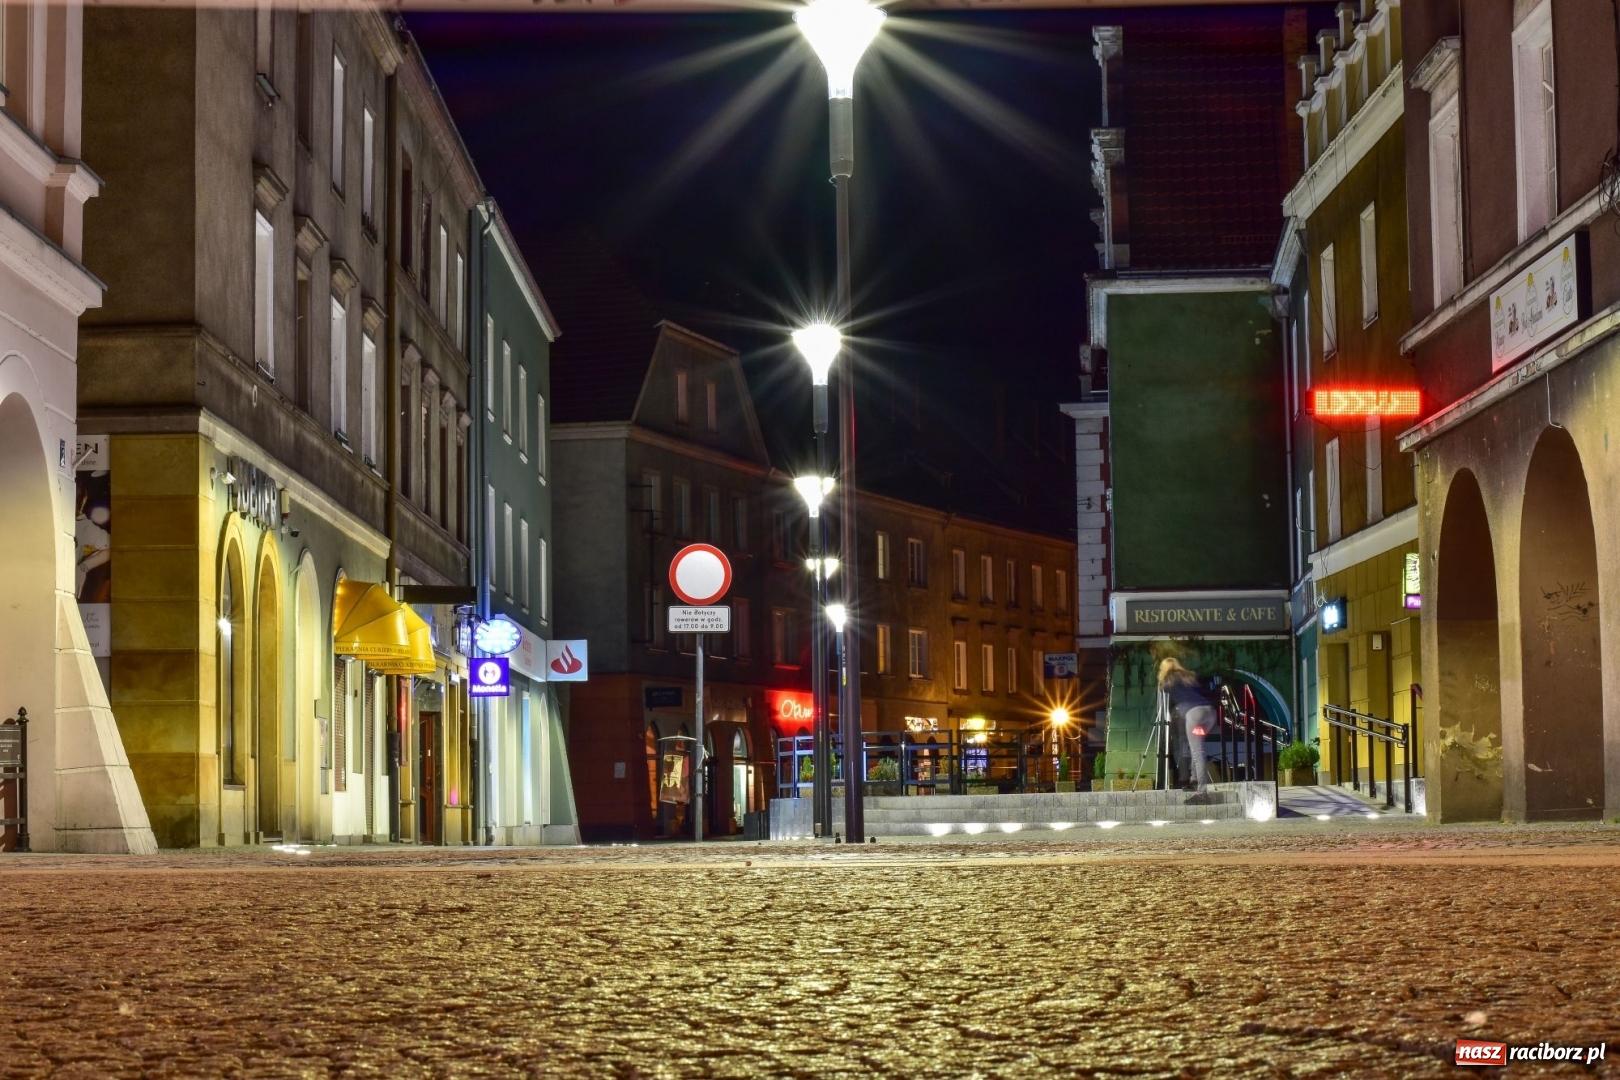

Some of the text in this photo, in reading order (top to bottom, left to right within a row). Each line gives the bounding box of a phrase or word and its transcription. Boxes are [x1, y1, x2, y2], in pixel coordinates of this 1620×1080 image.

[1134, 606, 1276, 623] RISTORANTE & CAFE
[472, 684, 507, 693] Monetia
